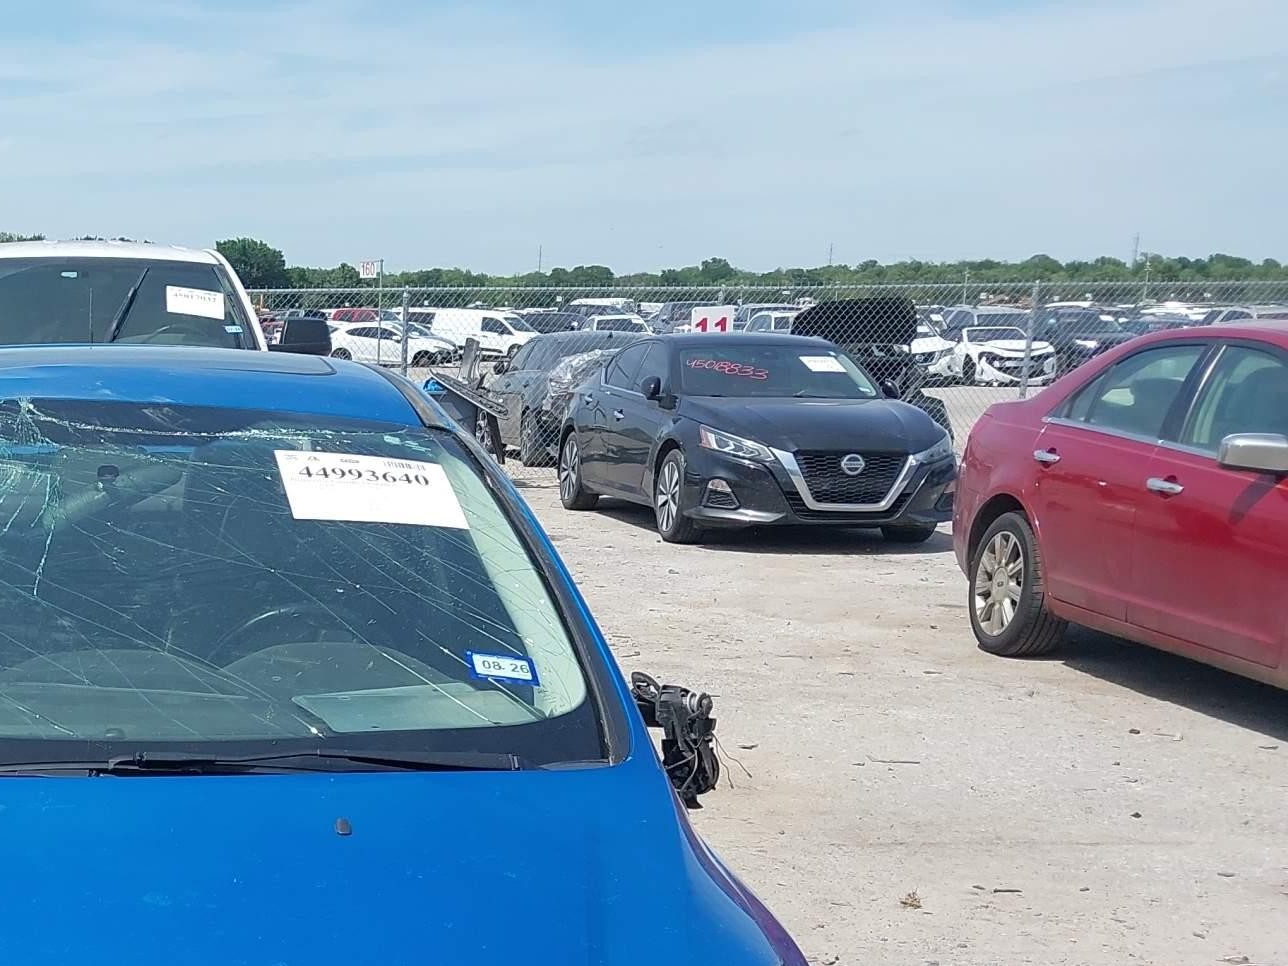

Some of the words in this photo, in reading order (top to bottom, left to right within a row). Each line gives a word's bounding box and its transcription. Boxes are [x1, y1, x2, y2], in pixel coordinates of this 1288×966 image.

[362, 261, 376, 276] 160
[695, 316, 727, 333] 11
[686, 359, 769, 380] 45018833
[298, 465, 430, 486] 44993640
[510, 663, 529, 674] 26
